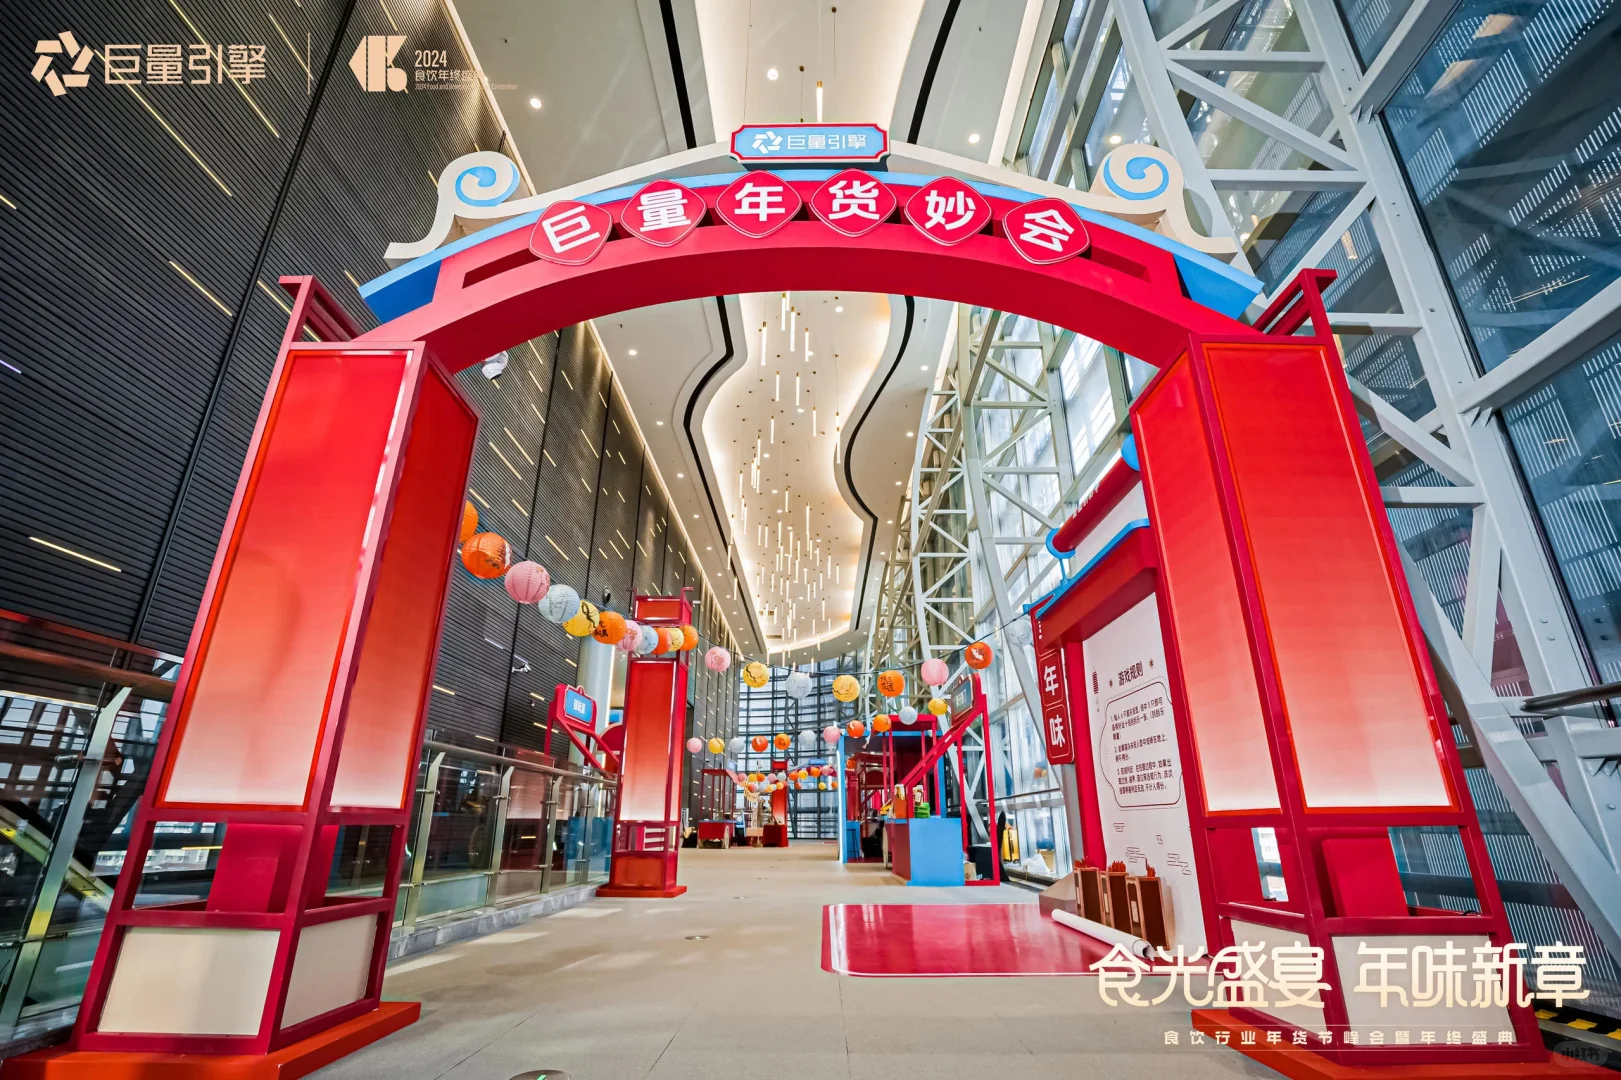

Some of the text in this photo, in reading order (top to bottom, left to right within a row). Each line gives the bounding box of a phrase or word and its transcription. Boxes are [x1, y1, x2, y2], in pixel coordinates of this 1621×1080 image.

[787, 133, 868, 150] 巨量引擎
[541, 179, 1077, 255] 巨量年货妙会
[1043, 664, 1066, 749] 年味
